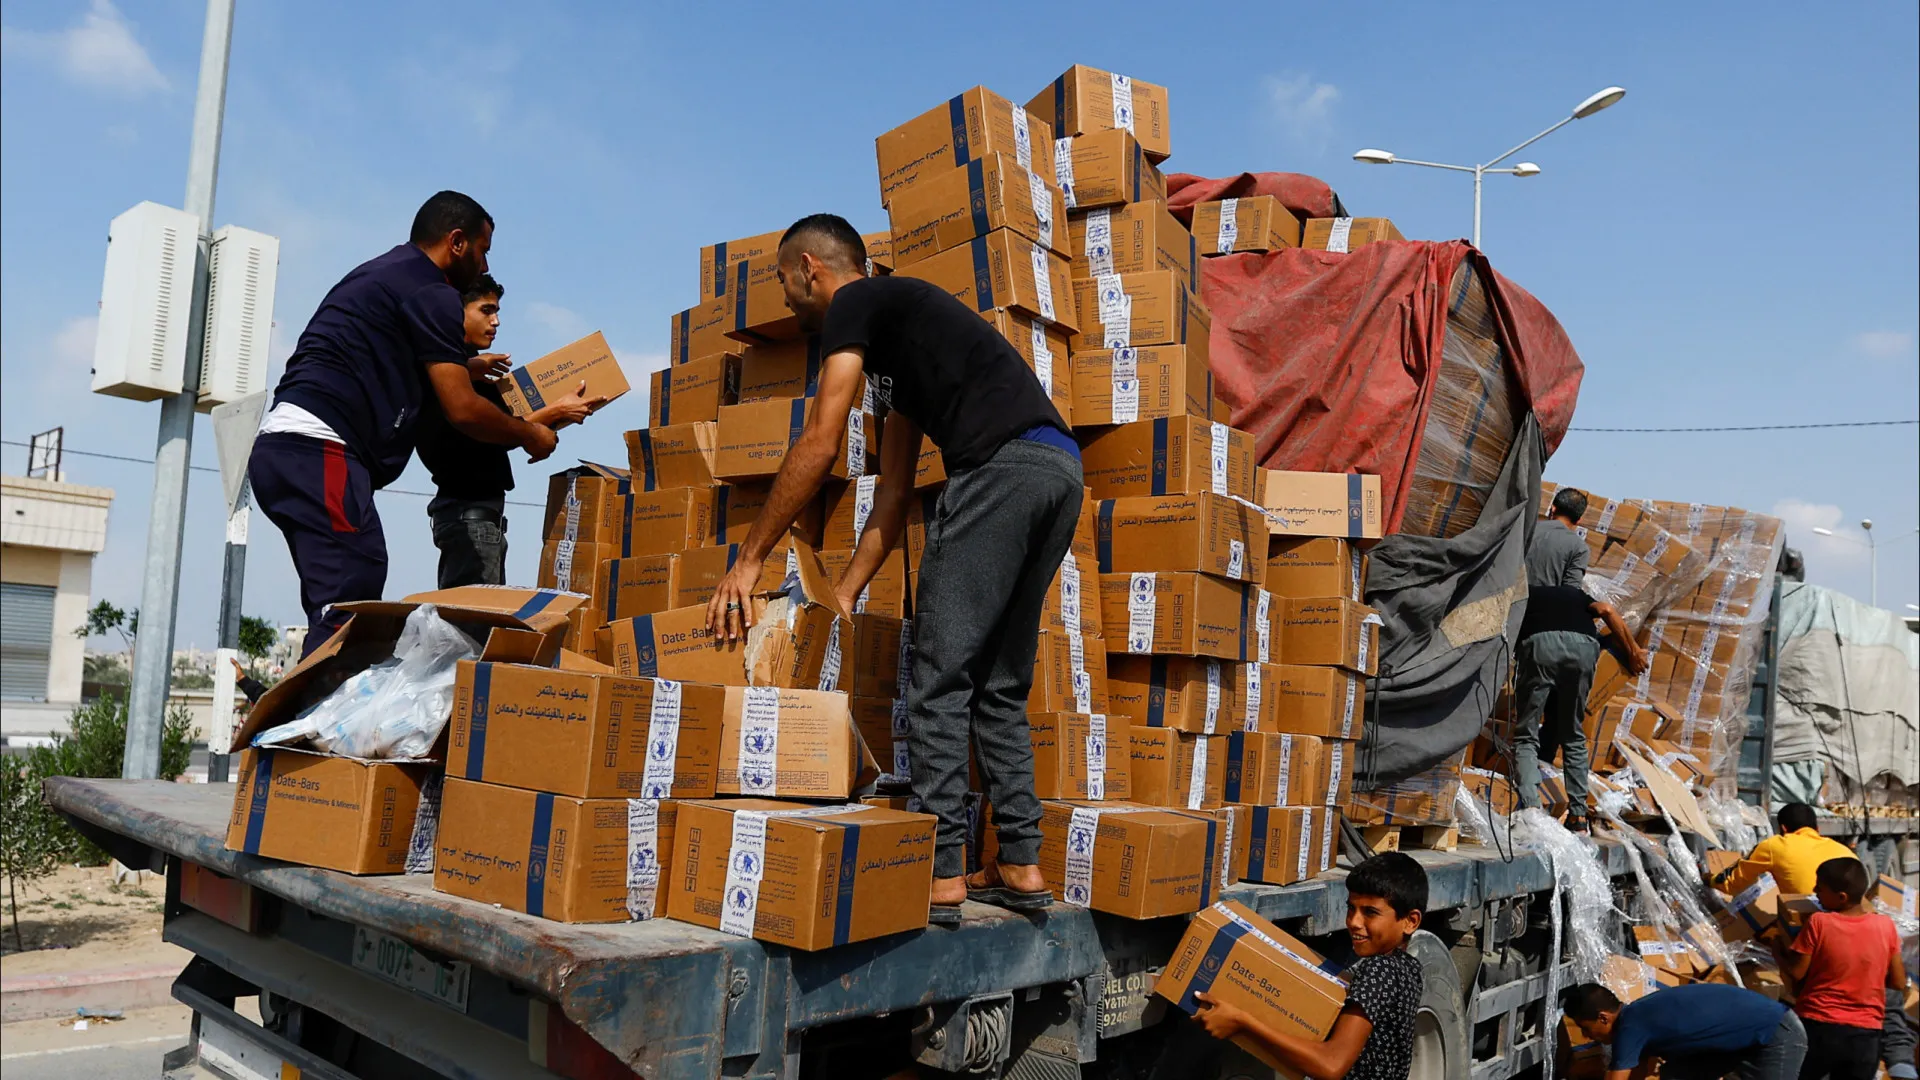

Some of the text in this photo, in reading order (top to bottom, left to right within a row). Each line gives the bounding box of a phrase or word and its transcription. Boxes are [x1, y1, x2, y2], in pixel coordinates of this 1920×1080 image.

[731, 252, 745, 261] Date
[751, 268, 764, 278] Date
[536, 369, 555, 382] Date
[767, 450, 783, 458] Date
[1129, 473, 1146, 482] Date
[662, 633, 686, 645] Date
[664, 645, 689, 657] Enriched
[689, 643, 703, 652] with
[536, 685, 589, 701] بسكويت بالتمر
[495, 703, 587, 724] مدعم بالفيتامينات والمعادن
[276, 773, 297, 788] Date
[274, 790, 295, 801] Enriched
[296, 795, 306, 803] with
[306, 795, 330, 806] Vitamins
[336, 800, 360, 810] Minerals
[896, 833, 932, 848] بسكويت بالتمر
[916, 854, 930, 865] مدعم
[1231, 960, 1256, 982] Date
[1225, 971, 1251, 991] Enriched
[1250, 988, 1263, 1000] with
[1264, 996, 1289, 1017] Vitamins
[1295, 1016, 1321, 1036] Minerals
